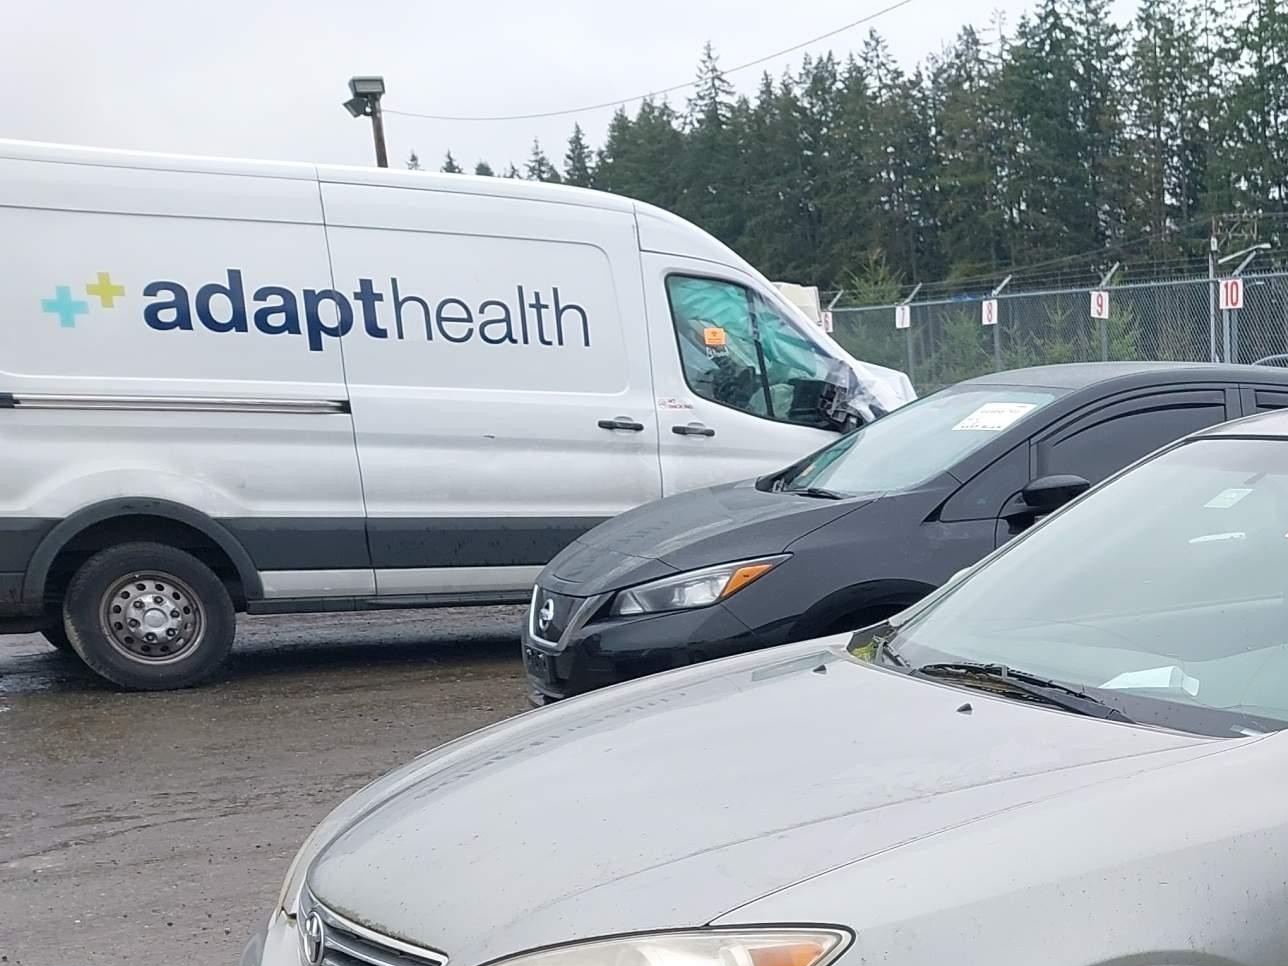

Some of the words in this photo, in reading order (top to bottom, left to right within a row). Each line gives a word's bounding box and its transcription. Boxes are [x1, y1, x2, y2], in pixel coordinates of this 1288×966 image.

[1096, 293, 1104, 317] 9
[1224, 281, 1239, 306] 10
[142, 268, 591, 352] adapthealth
[986, 302, 993, 323] 8
